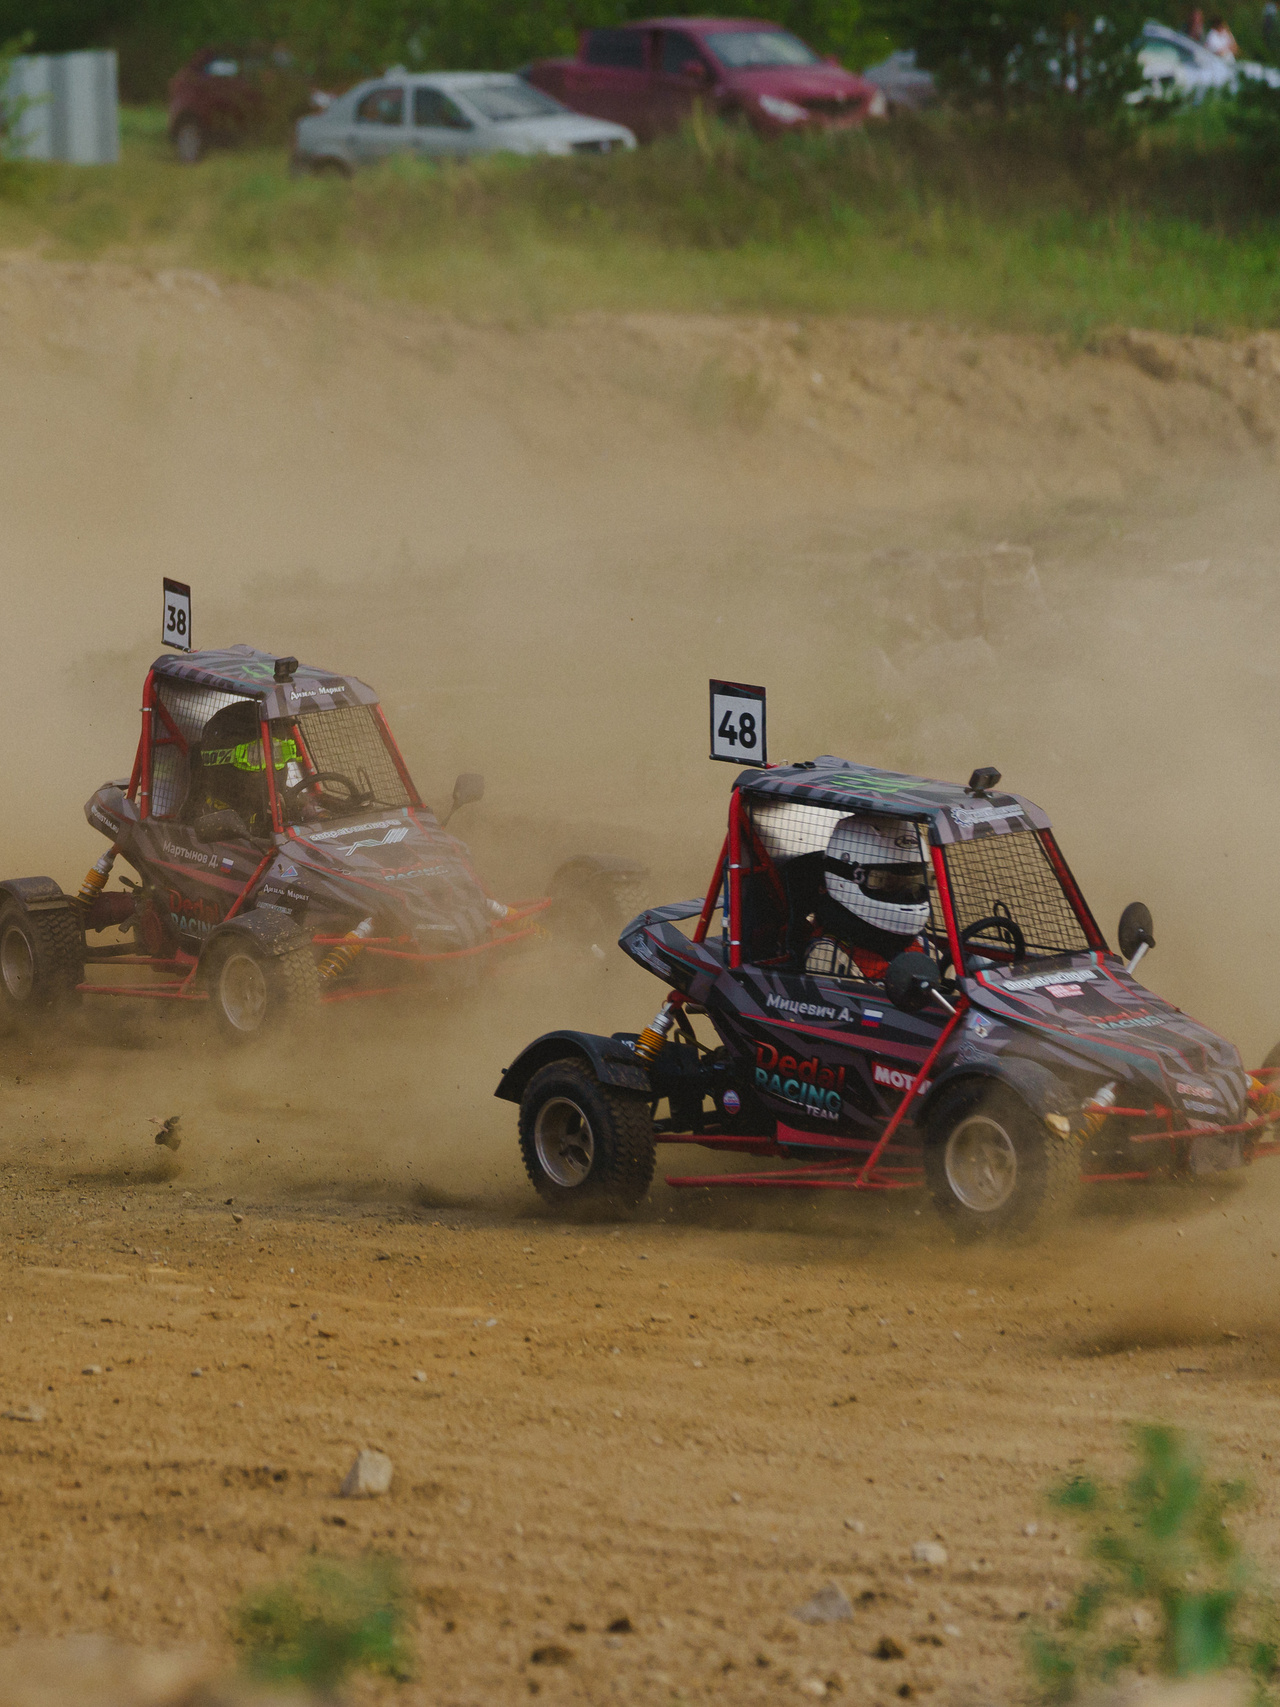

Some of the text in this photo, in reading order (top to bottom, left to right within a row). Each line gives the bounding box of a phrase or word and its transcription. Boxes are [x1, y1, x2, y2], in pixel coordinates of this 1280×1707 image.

[167, 605, 186, 635] 38
[718, 710, 756, 748] 48
[163, 840, 219, 868] Мартынов Д.
[766, 993, 854, 1022] Мицевич А.
[752, 1039, 845, 1091] Dedal
[755, 1067, 841, 1112] RACING
[806, 1104, 839, 1120] TEAM
